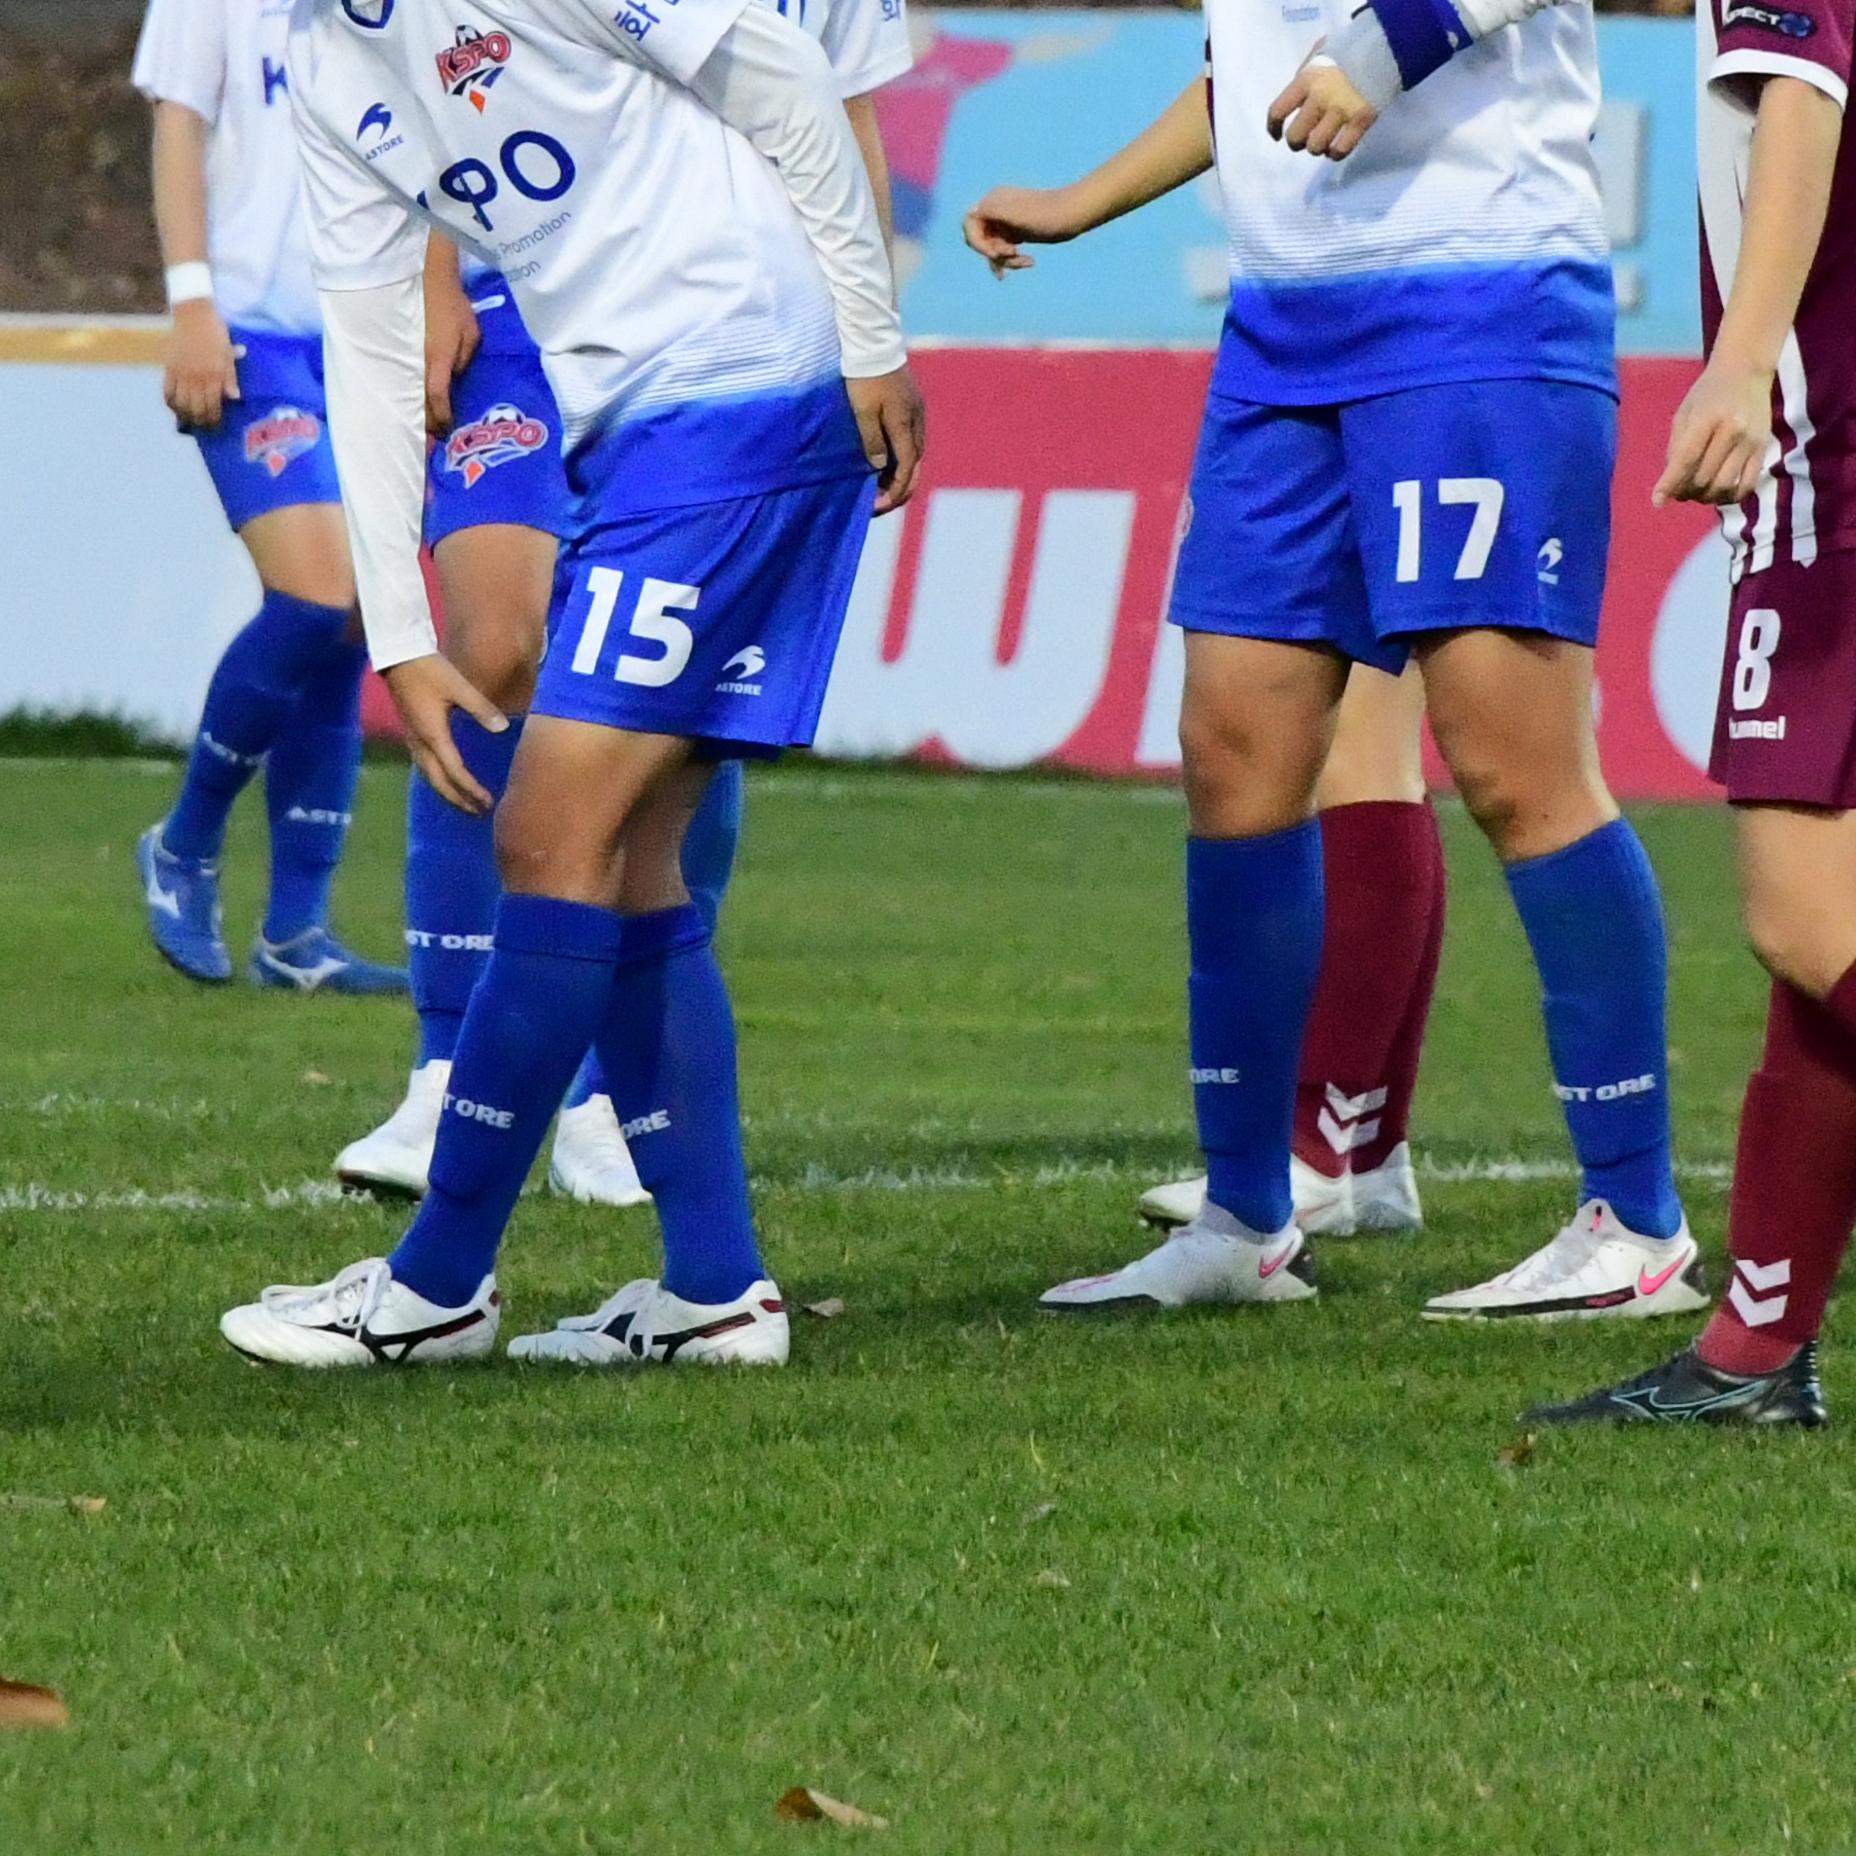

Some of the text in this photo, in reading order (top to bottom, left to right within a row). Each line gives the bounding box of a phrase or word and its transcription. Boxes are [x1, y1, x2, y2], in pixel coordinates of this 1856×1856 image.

[435, 31, 511, 93] KSPO
[1392, 477, 1505, 583] 17
[572, 567, 701, 687] 15
[1733, 609, 1781, 711] 8
